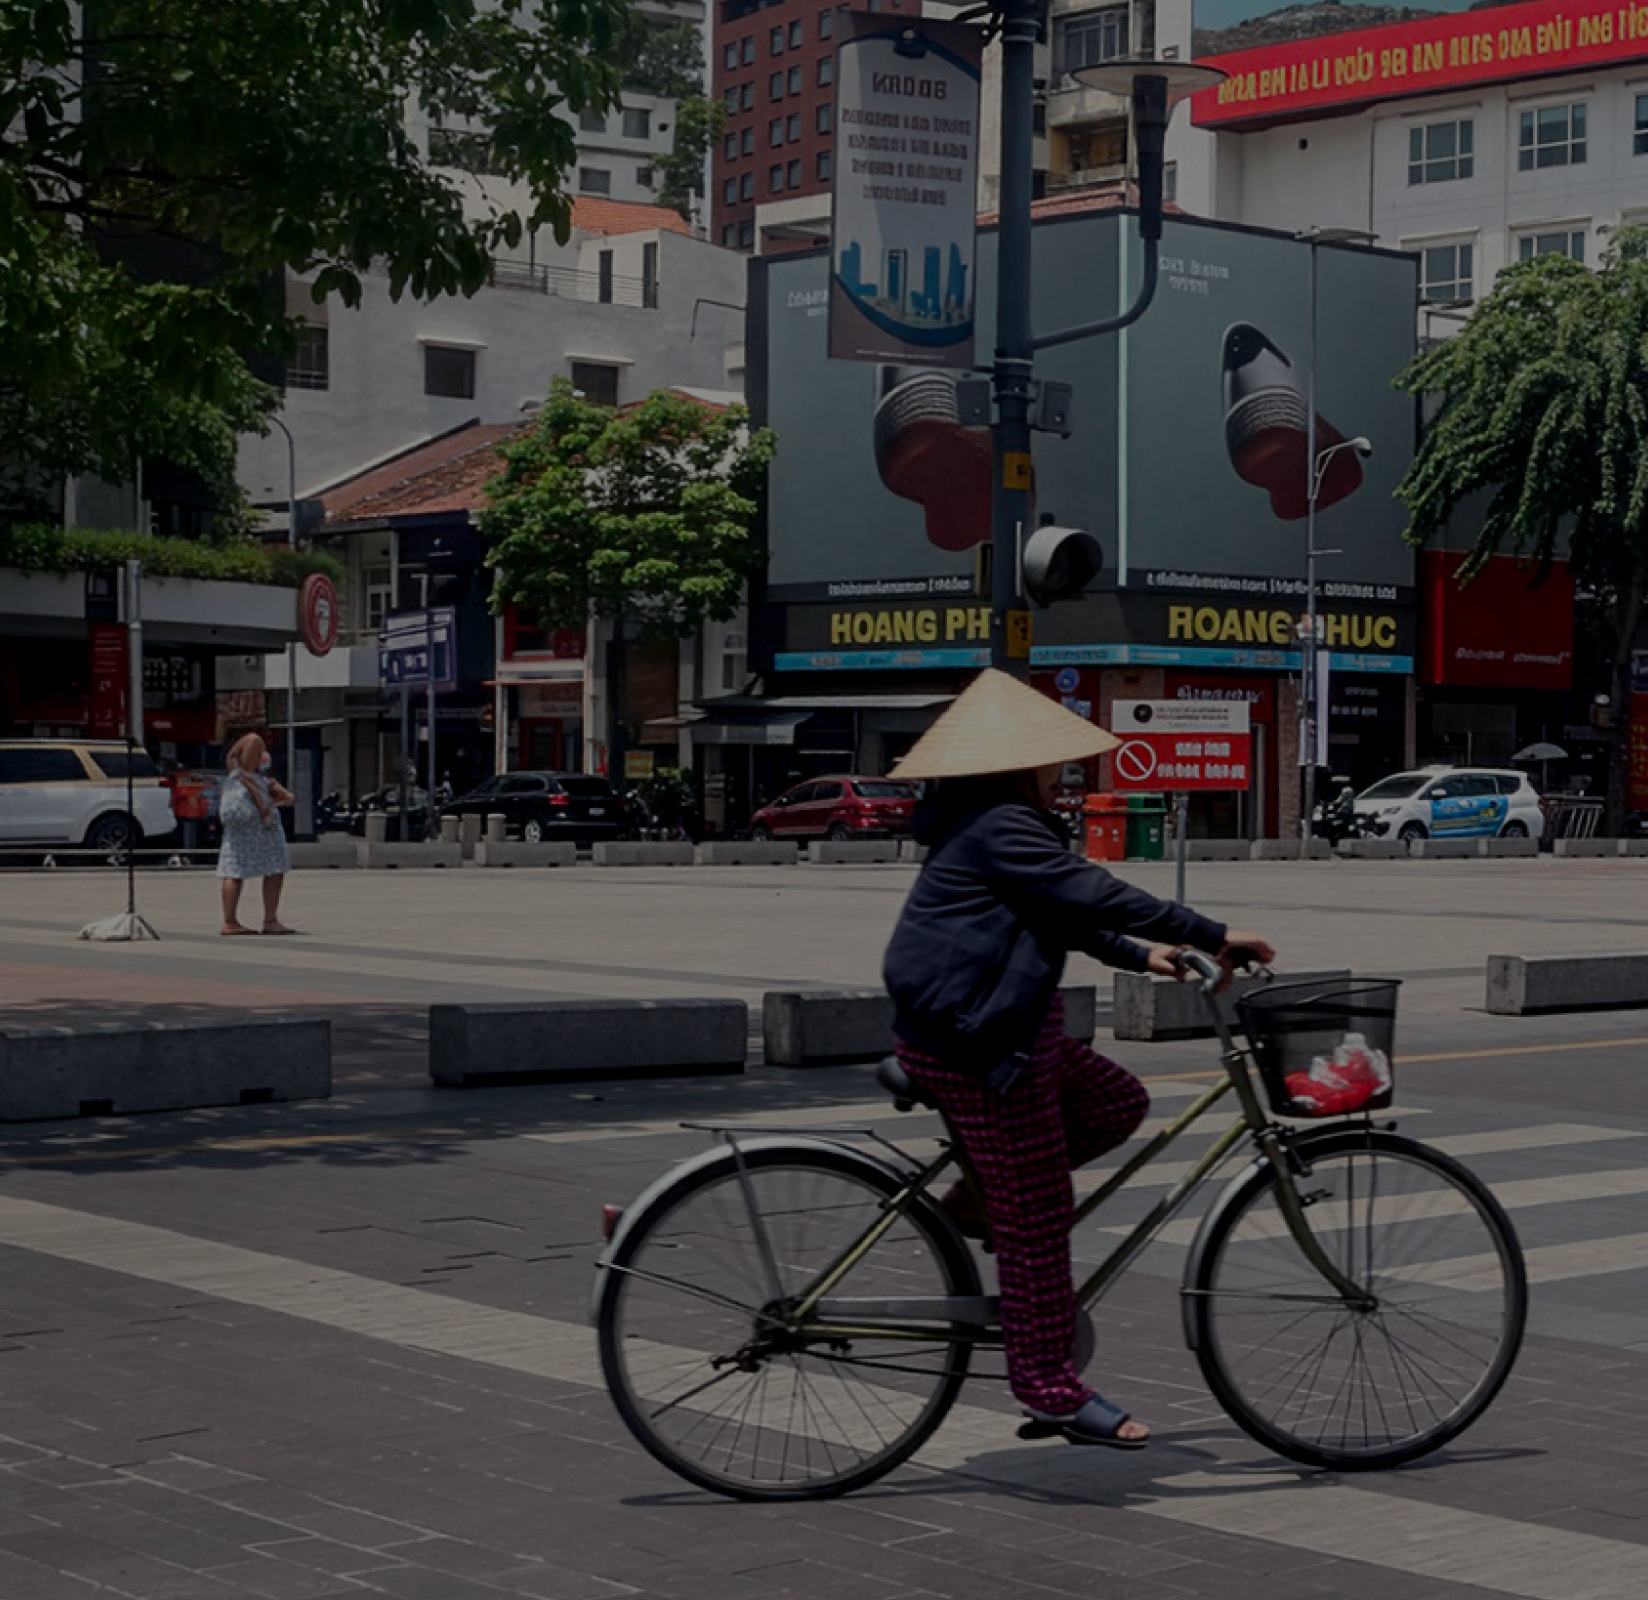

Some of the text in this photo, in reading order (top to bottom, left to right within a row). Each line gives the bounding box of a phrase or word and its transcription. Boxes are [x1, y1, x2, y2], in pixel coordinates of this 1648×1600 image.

[831, 607, 991, 645] HOANG PH
[1318, 613, 1398, 649] HUC
